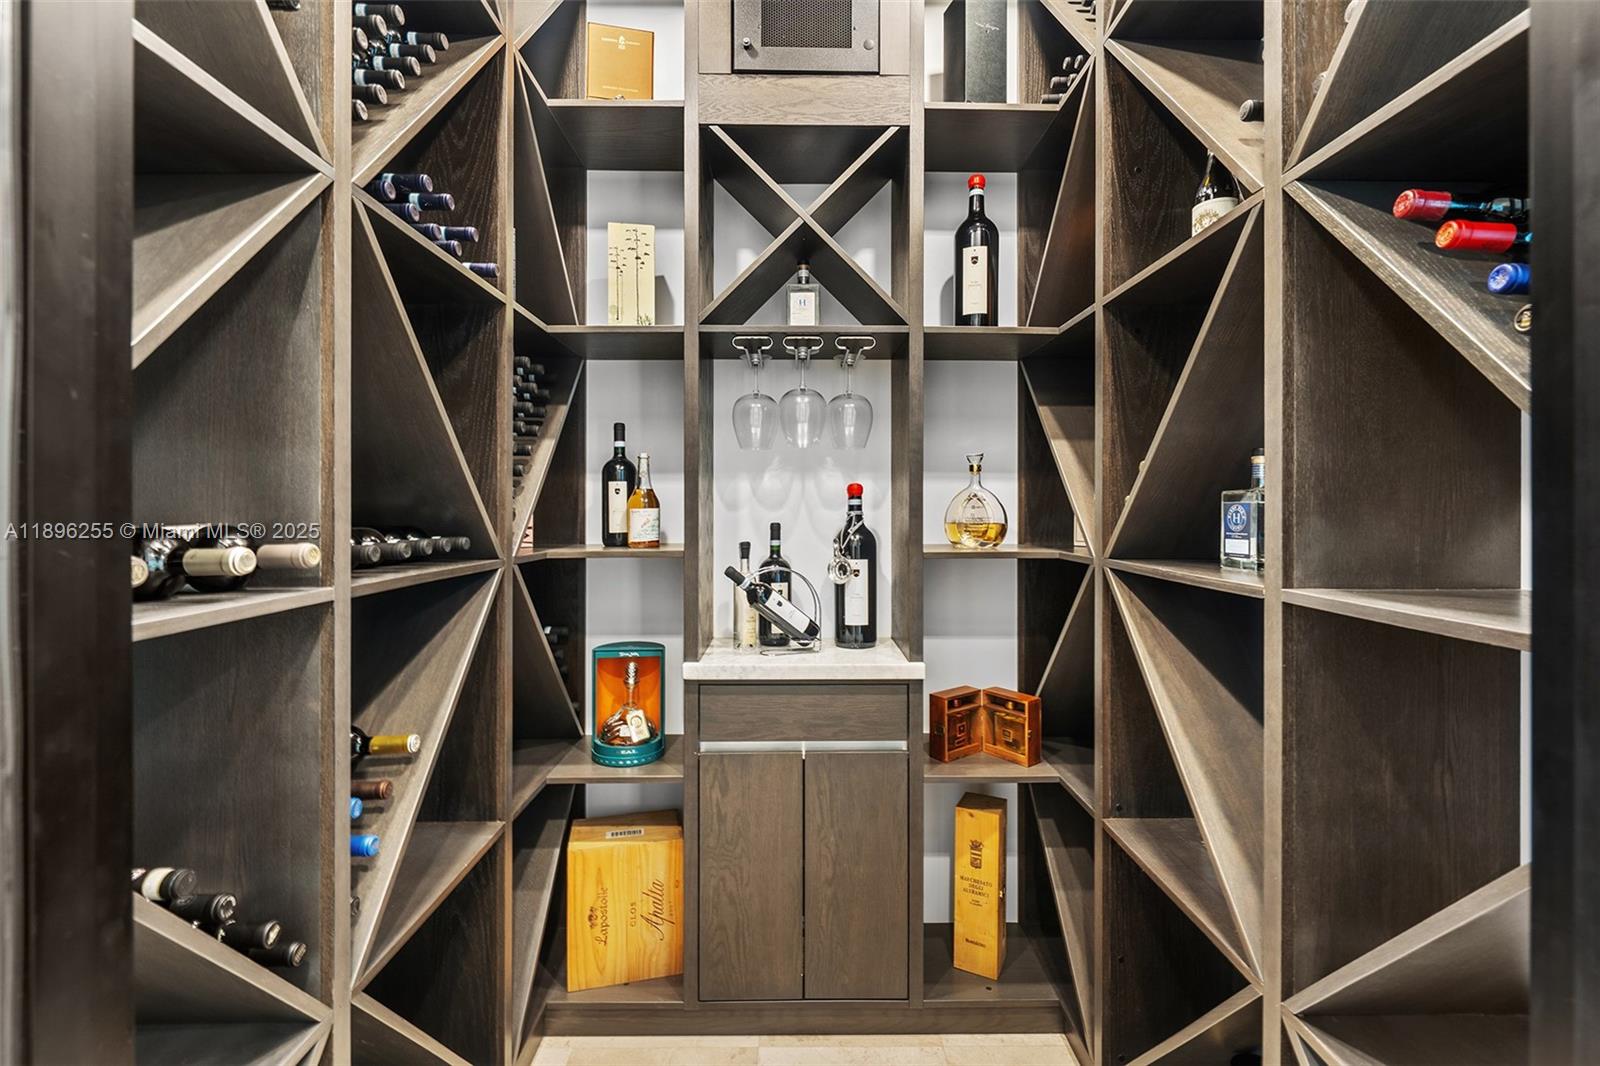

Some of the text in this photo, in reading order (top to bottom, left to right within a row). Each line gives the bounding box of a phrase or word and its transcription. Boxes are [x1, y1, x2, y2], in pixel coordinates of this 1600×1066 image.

[595, 887, 609, 945] Lapostolle
[629, 901, 637, 927] CLOS
[640, 879, 675, 941] Apalta
